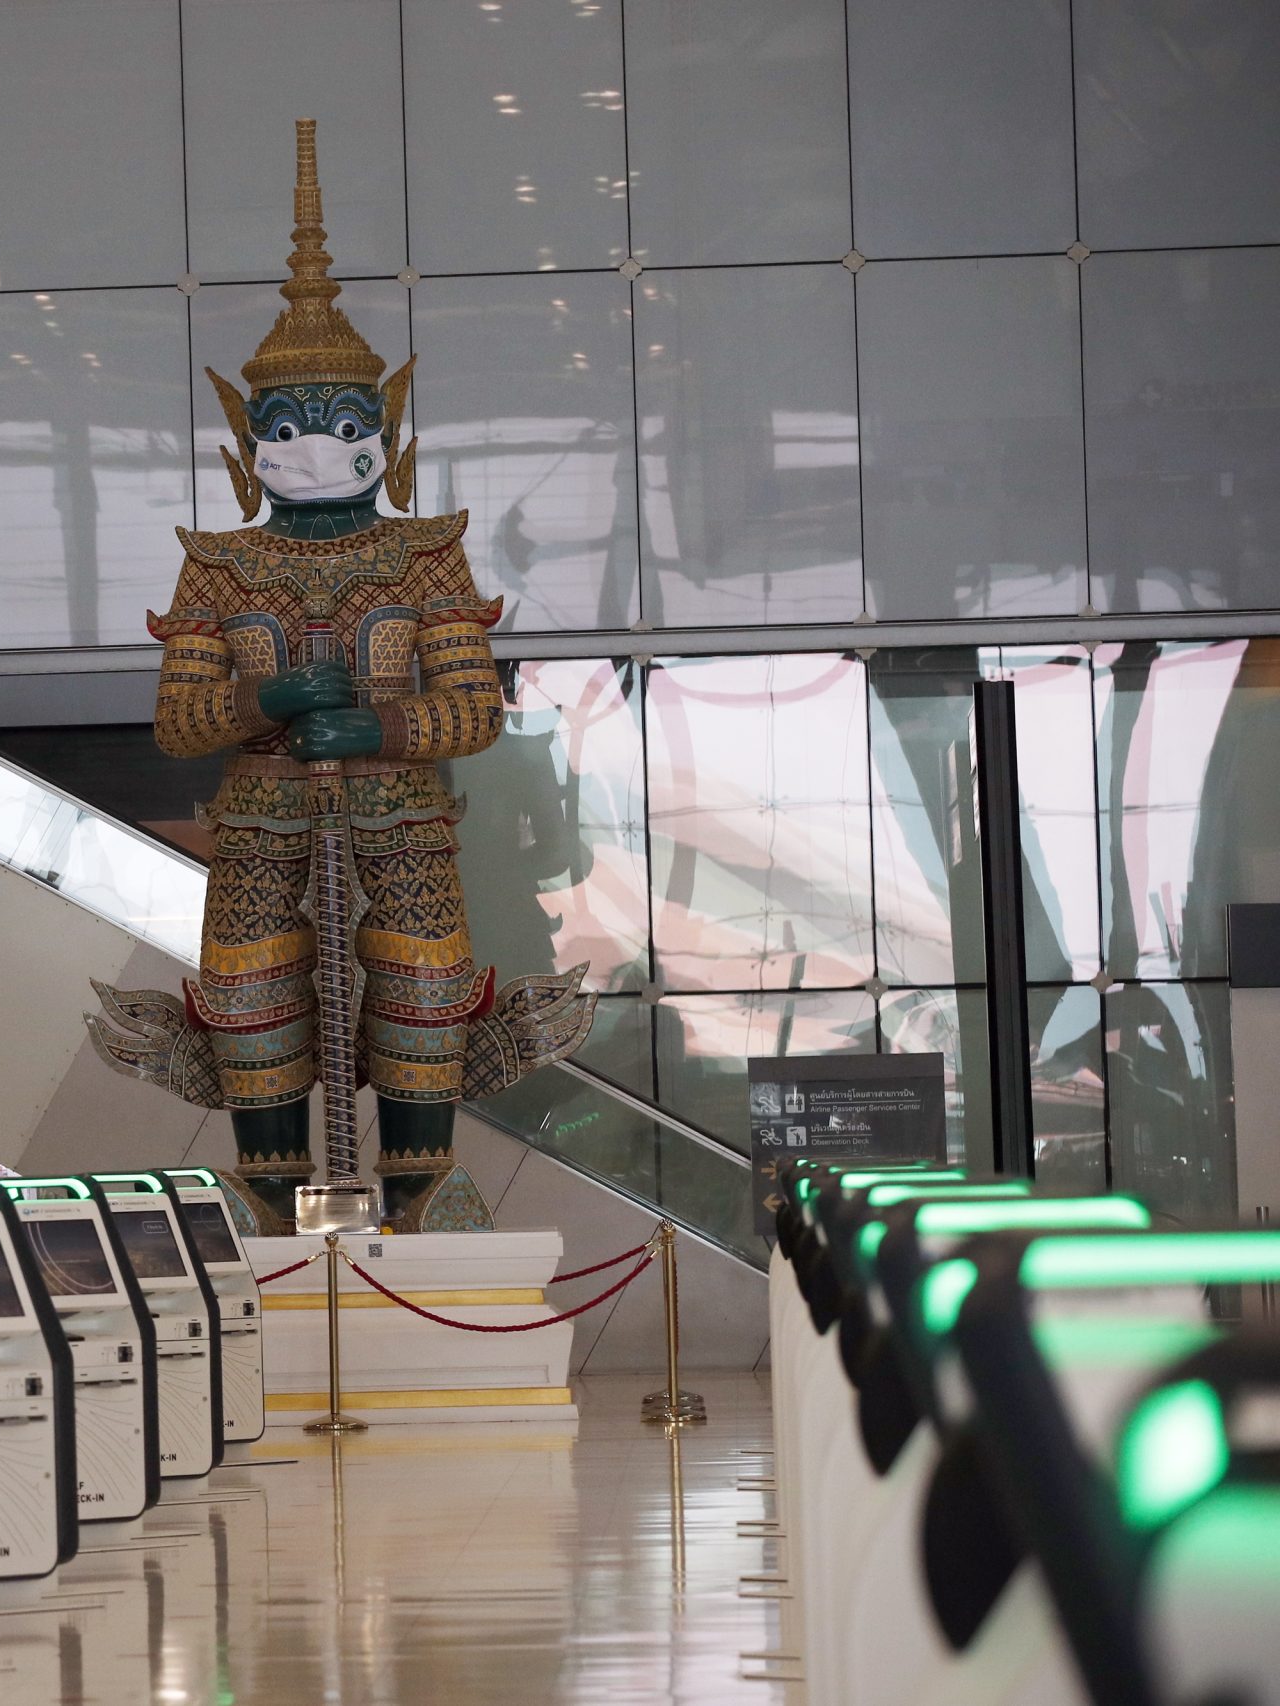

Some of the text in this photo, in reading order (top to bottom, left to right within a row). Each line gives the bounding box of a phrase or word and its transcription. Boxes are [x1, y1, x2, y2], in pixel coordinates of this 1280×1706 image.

[832, 1105, 867, 1113] Passenger
[811, 1137, 870, 1146] Observation Deck
